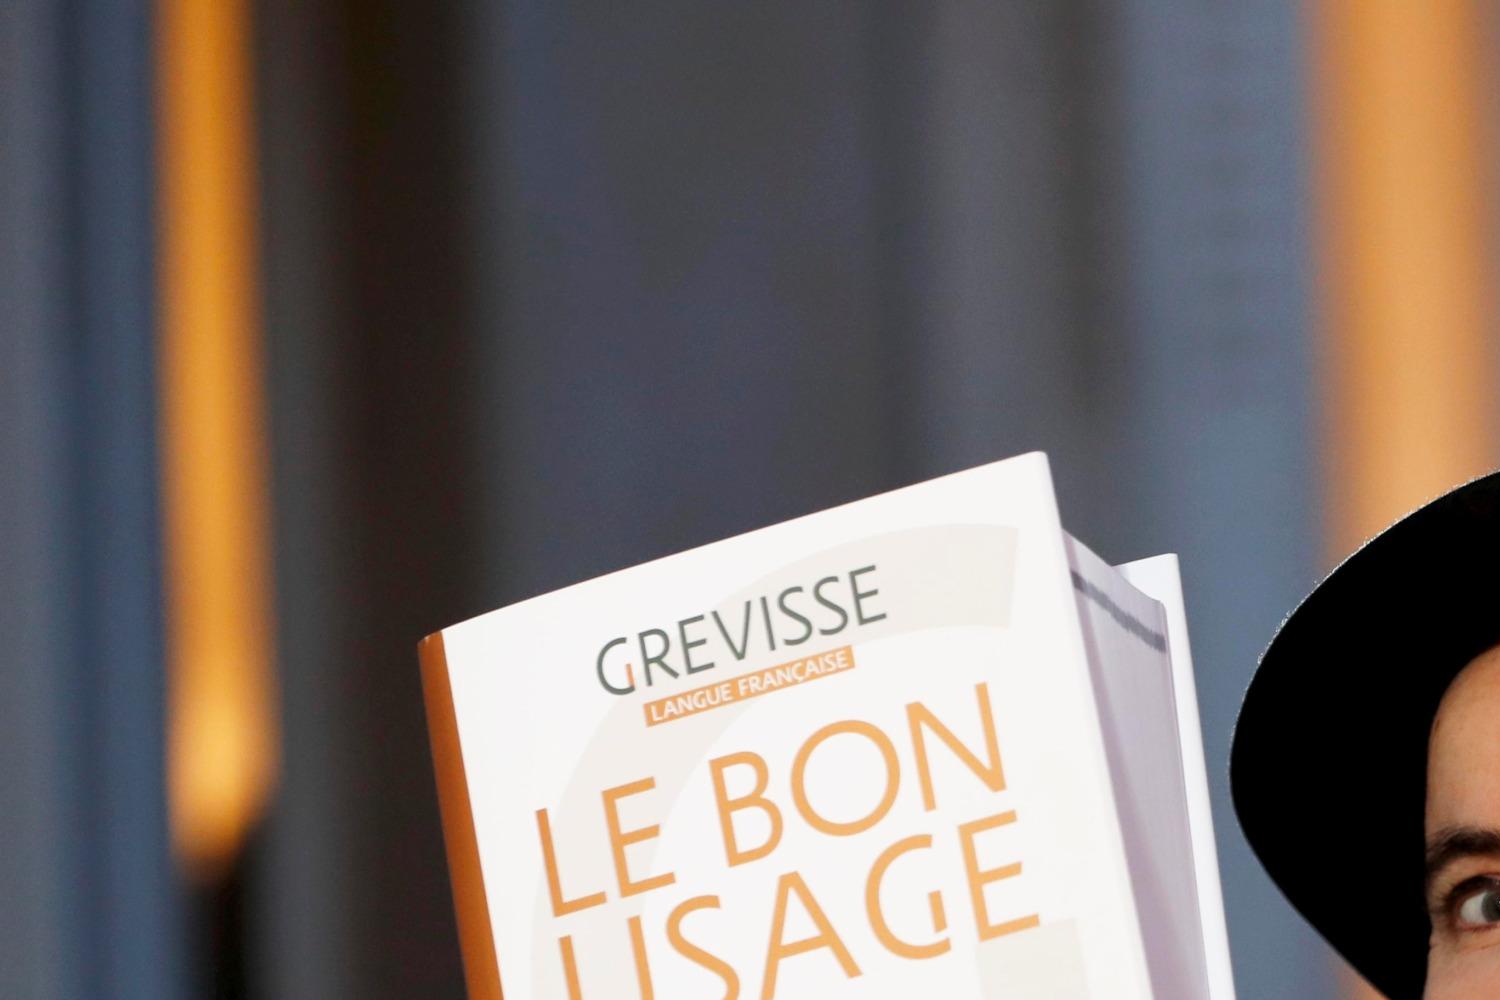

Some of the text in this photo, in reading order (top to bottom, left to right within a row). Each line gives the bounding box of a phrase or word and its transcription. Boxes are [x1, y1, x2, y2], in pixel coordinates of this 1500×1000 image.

[596, 564, 888, 696] GREVISSE
[650, 648, 849, 722] LANGUE FRANÇAISE
[535, 681, 1007, 918] LE BON
